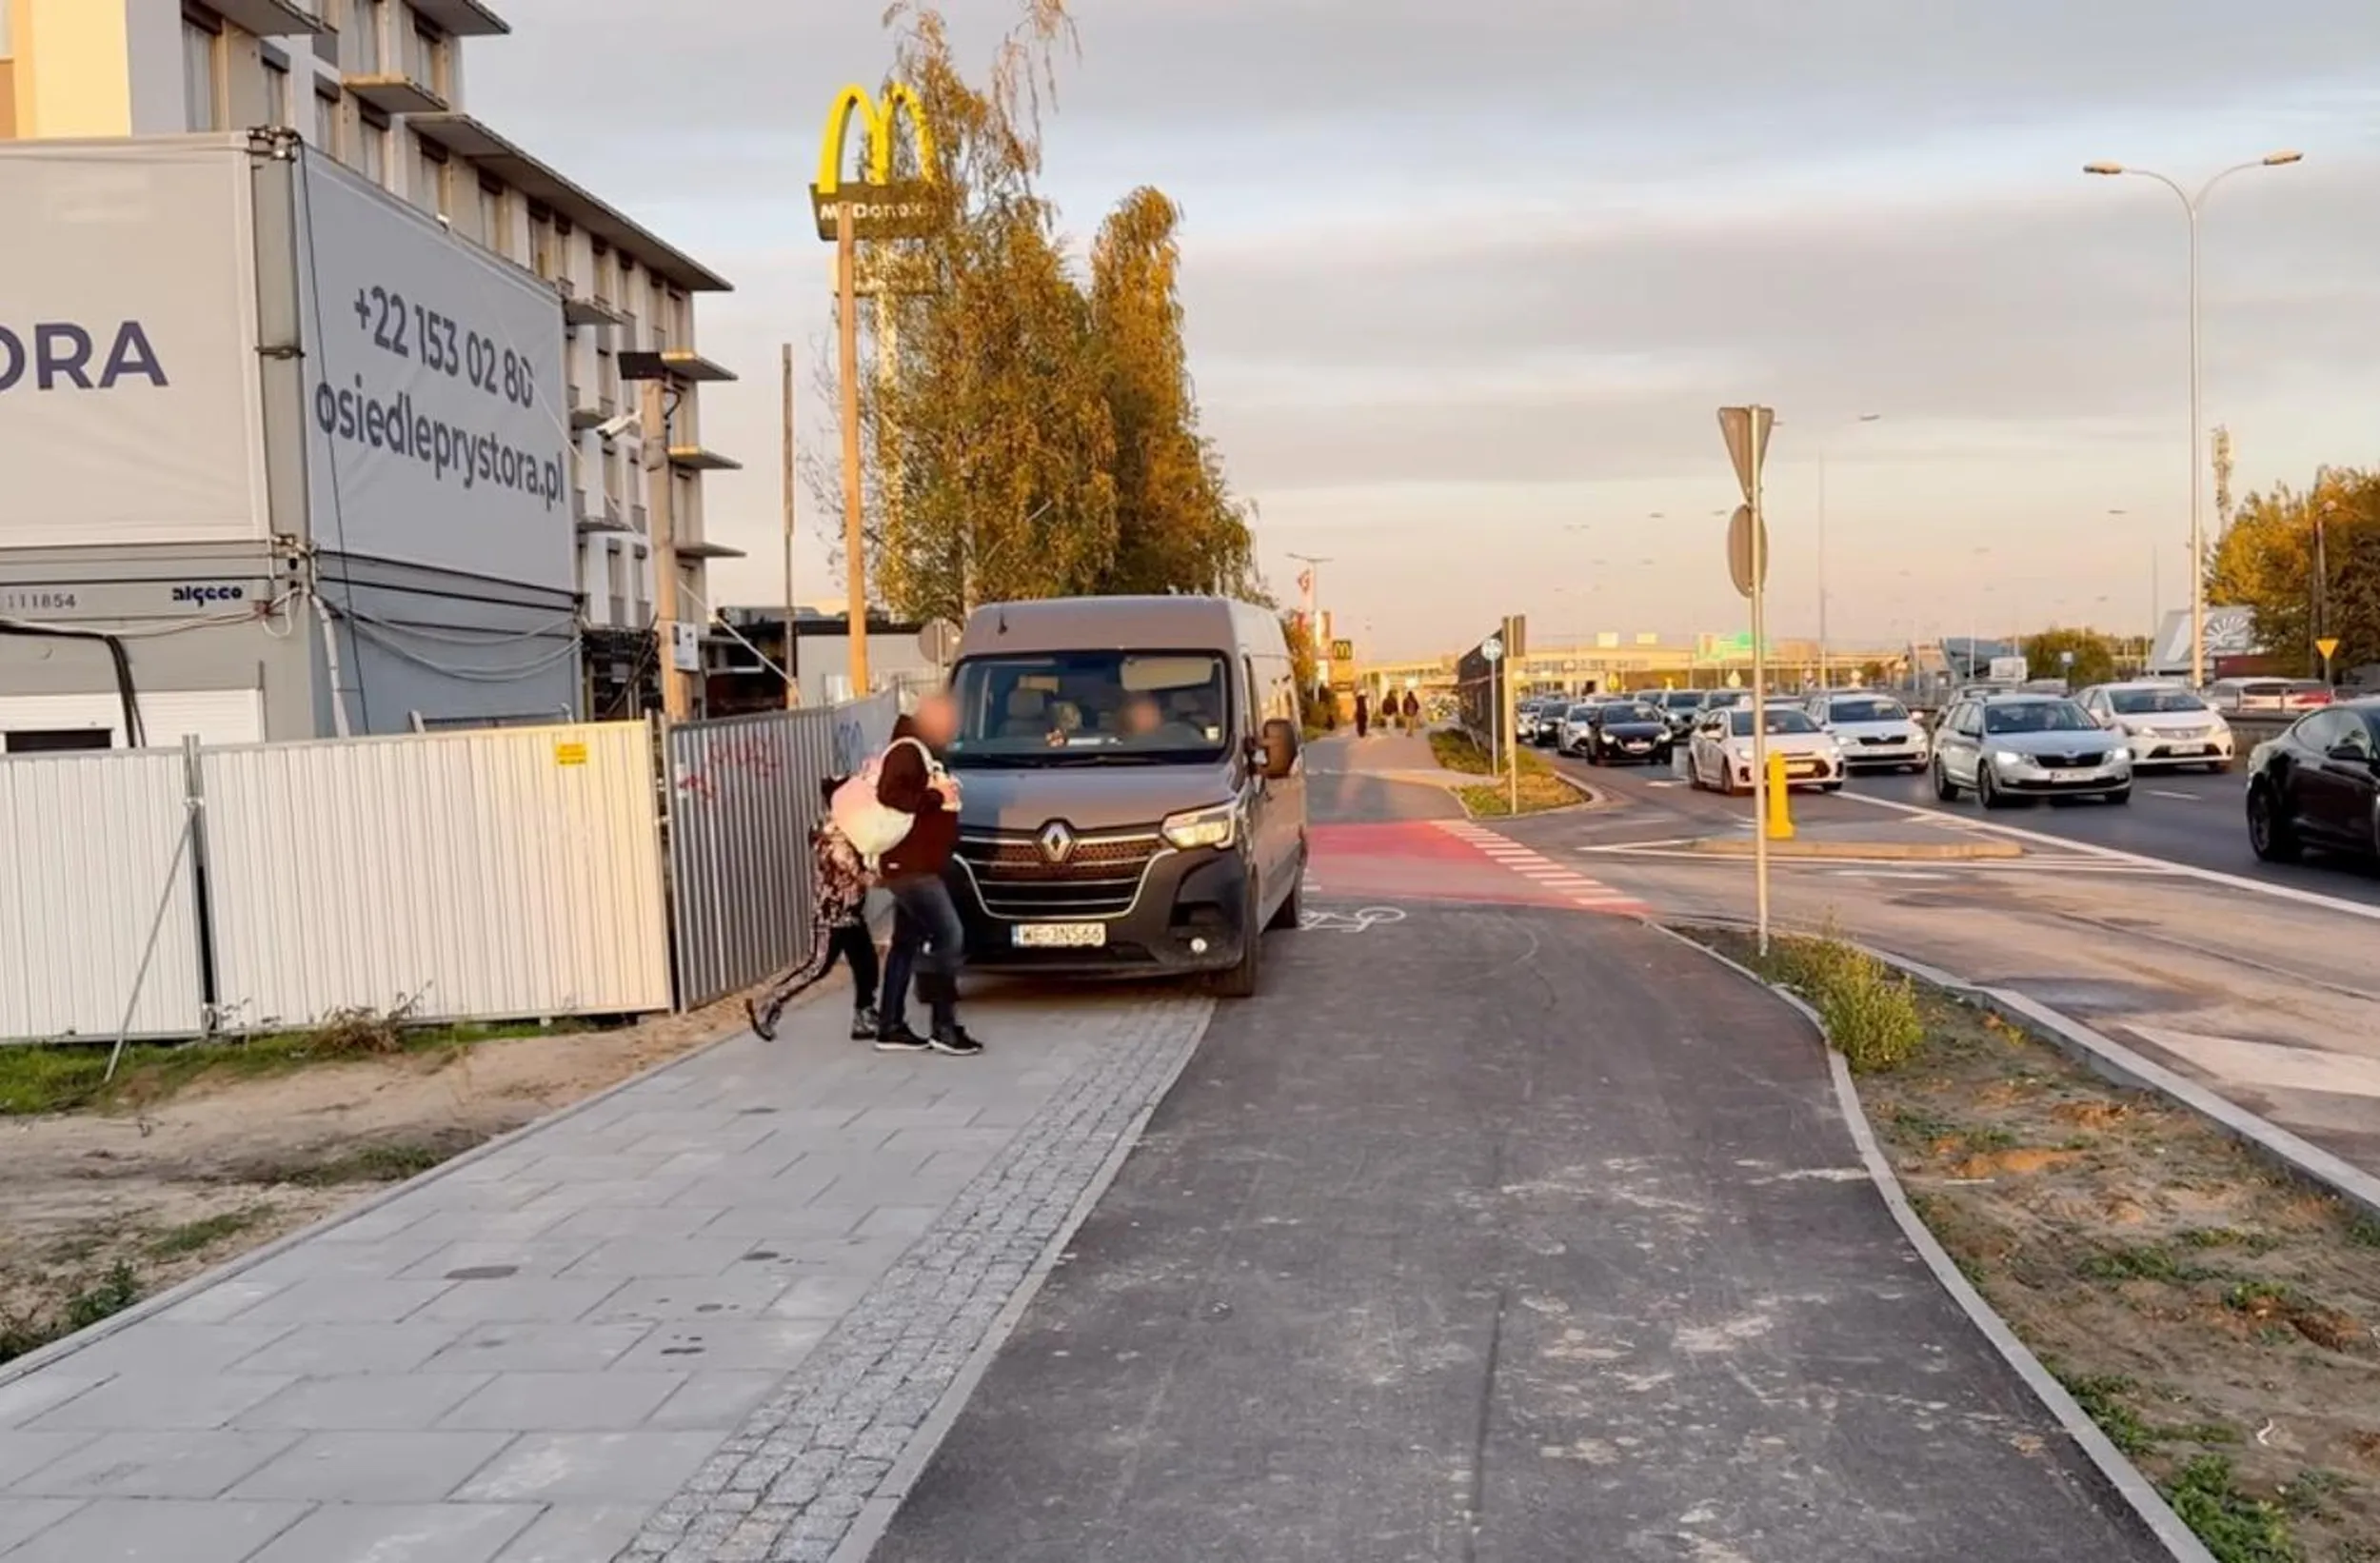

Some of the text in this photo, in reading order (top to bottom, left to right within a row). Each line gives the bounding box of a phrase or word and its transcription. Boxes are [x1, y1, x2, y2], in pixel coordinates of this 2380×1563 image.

[353, 286, 408, 358] +22
[415, 304, 459, 377] 153
[466, 331, 498, 395] 02
[315, 372, 565, 512] osiedleprystora.pl
